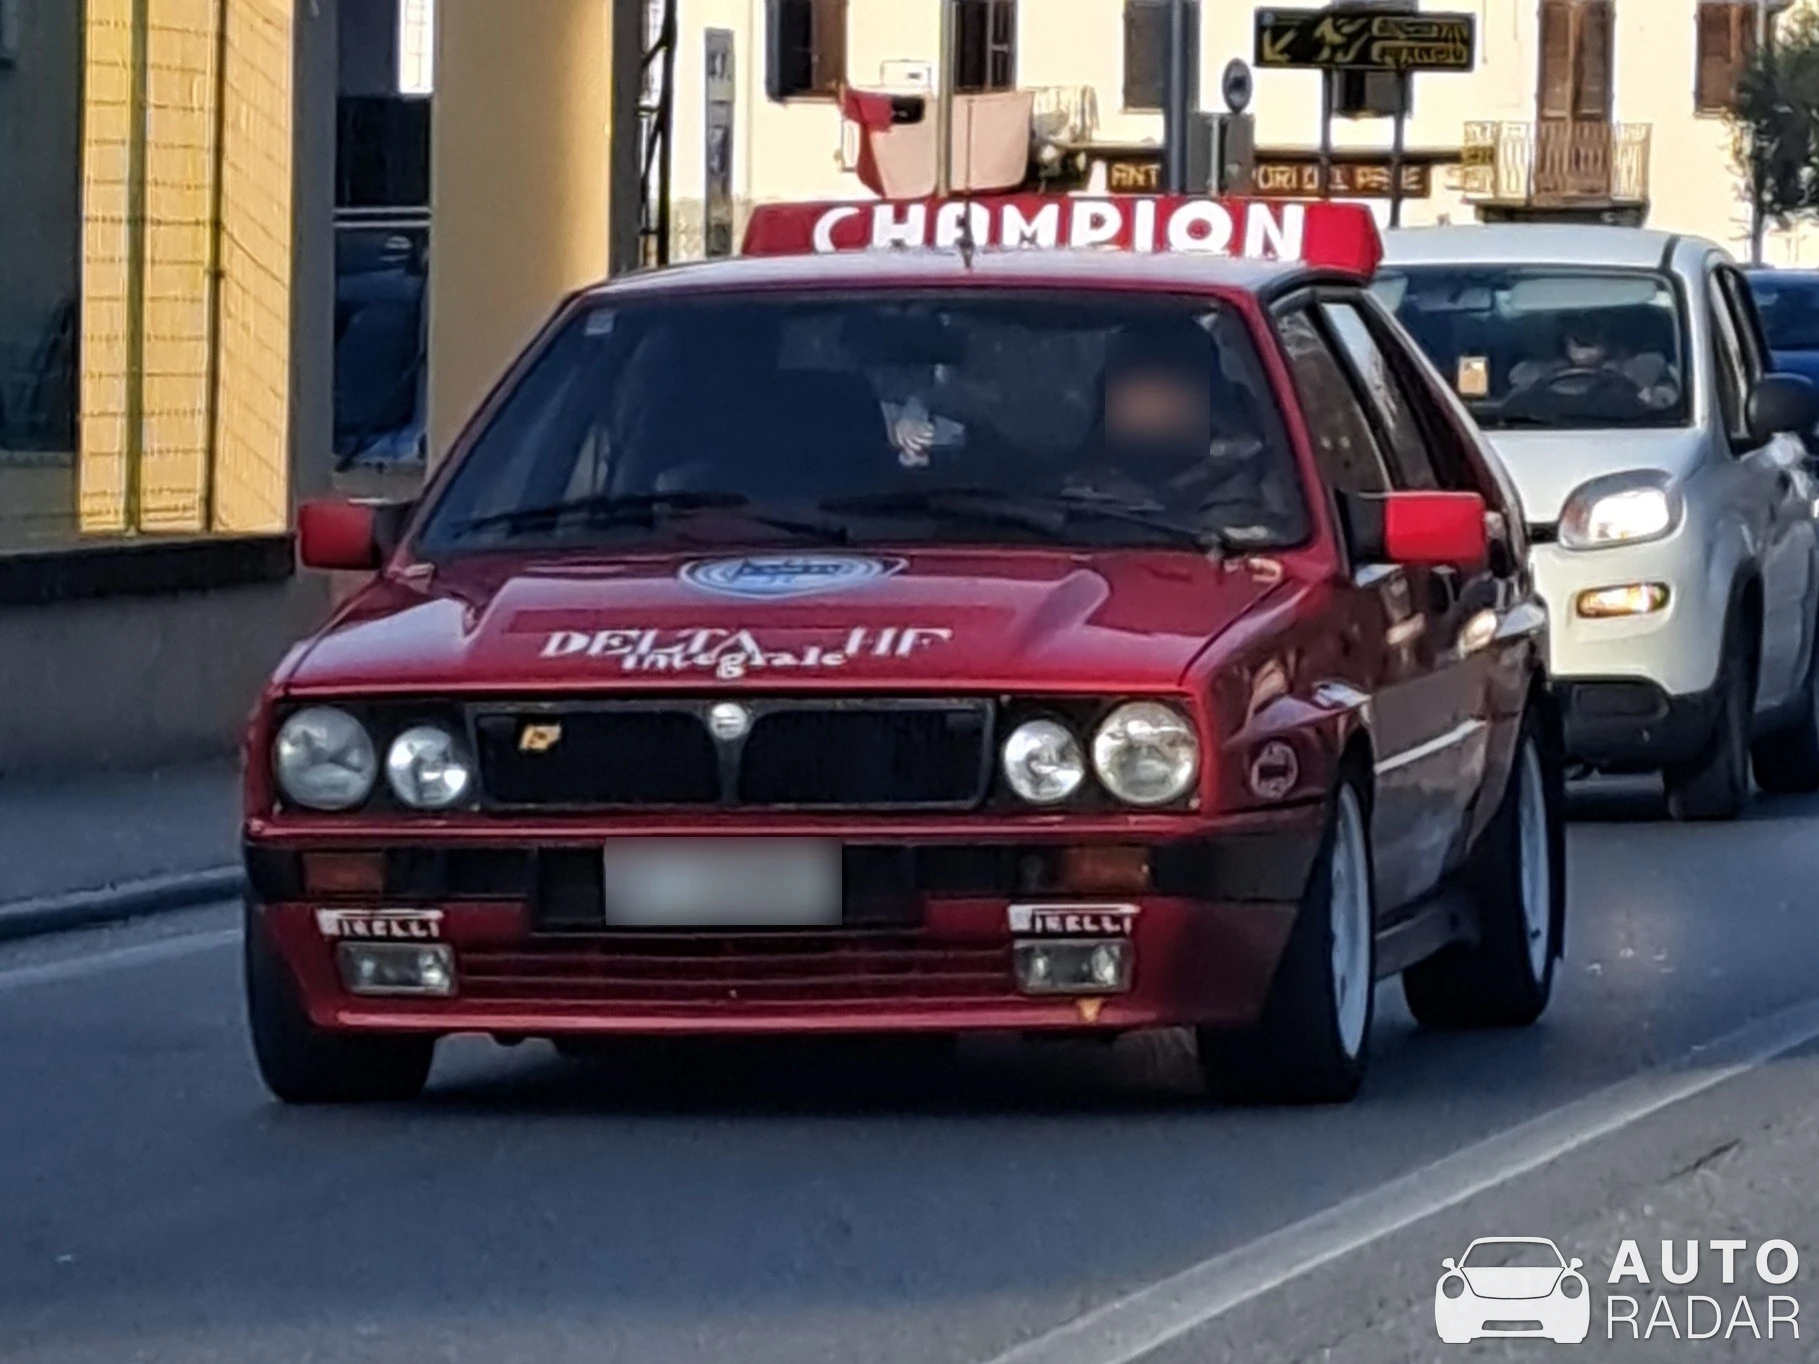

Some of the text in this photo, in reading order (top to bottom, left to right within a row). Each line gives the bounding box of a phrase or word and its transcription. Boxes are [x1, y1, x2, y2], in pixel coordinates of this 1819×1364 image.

[1110, 163, 1161, 188] ANT
[812, 199, 1305, 262] CHAMPION
[540, 627, 953, 658] DELTA HF
[314, 908, 444, 938] PIRELLI
[1008, 903, 1141, 933] PIRELLI
